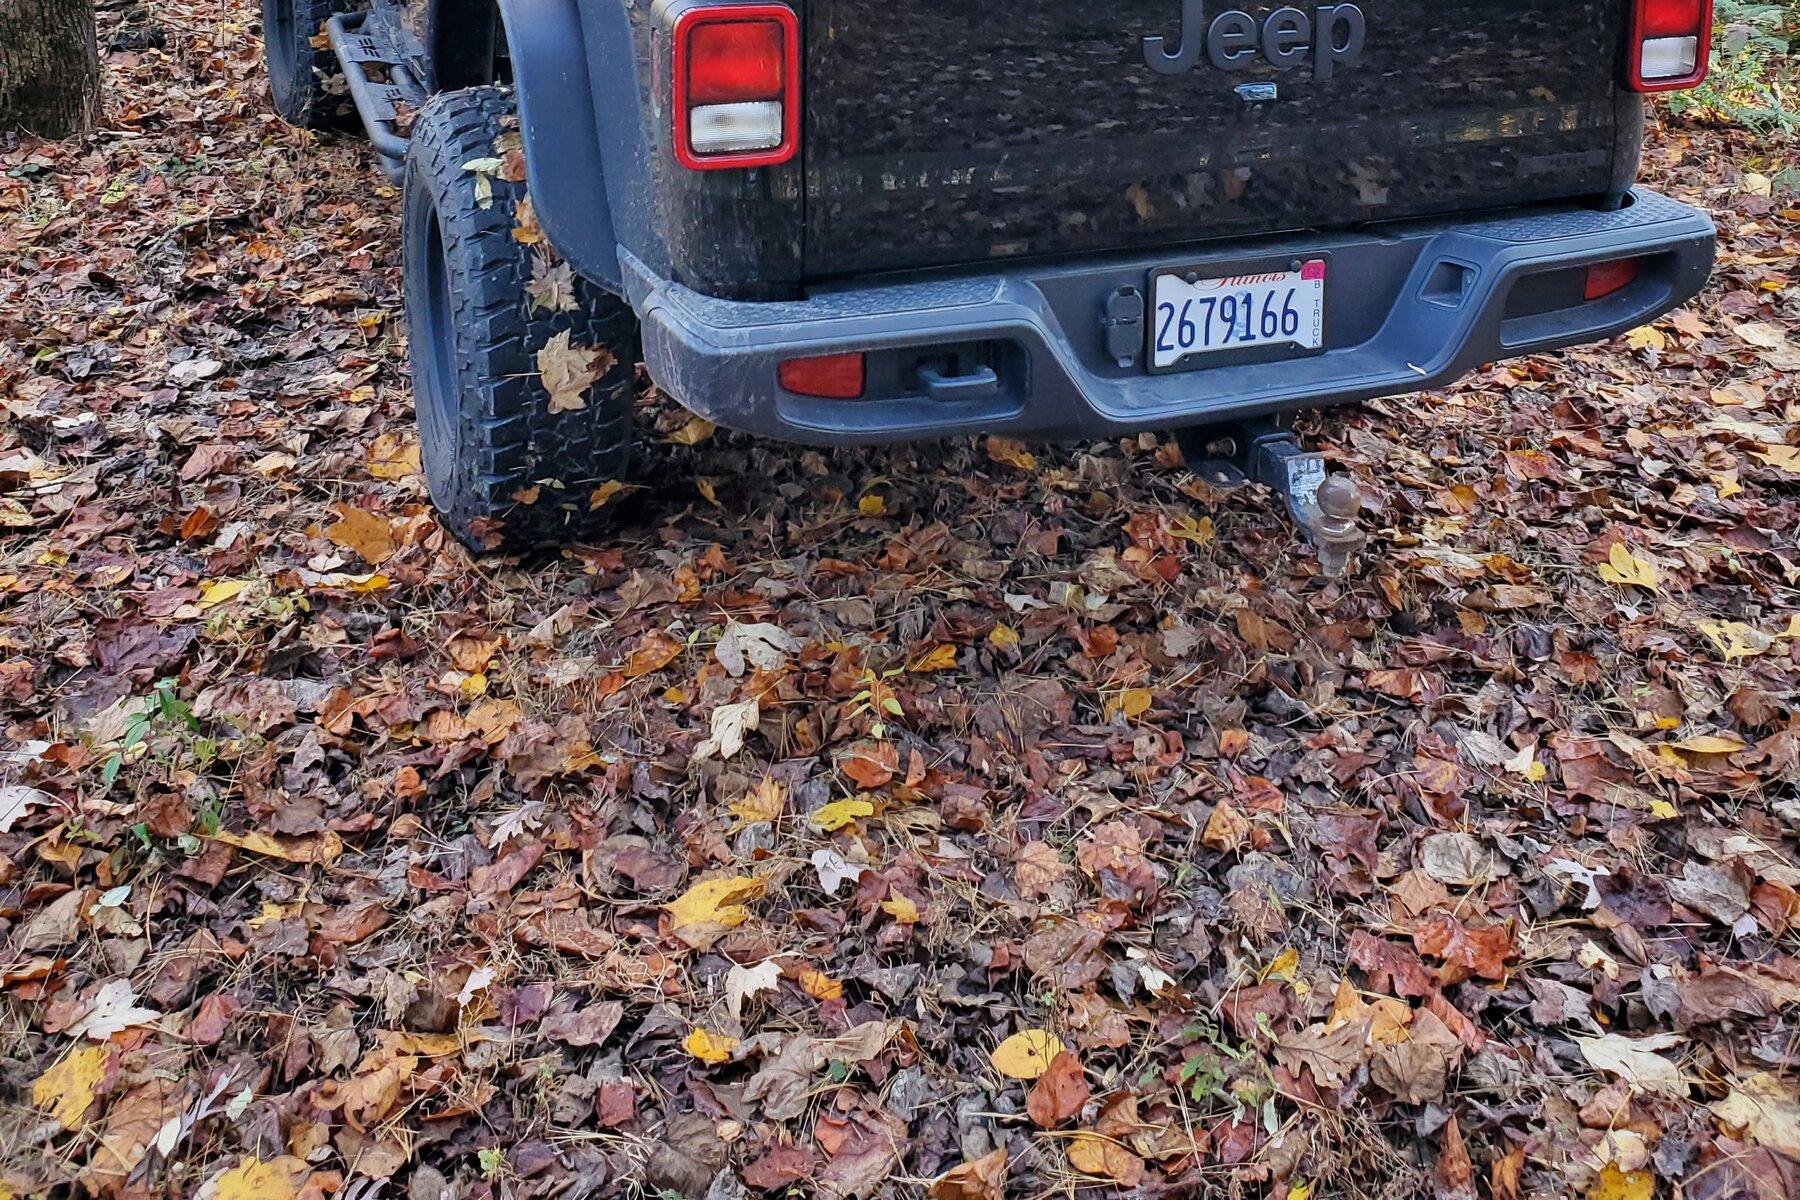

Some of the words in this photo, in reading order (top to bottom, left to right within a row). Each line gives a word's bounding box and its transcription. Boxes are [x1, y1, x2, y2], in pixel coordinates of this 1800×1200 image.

[1314, 280, 1321, 289] B
[1156, 288, 1299, 351] 2679166
[1312, 300, 1321, 347] TRUCK
